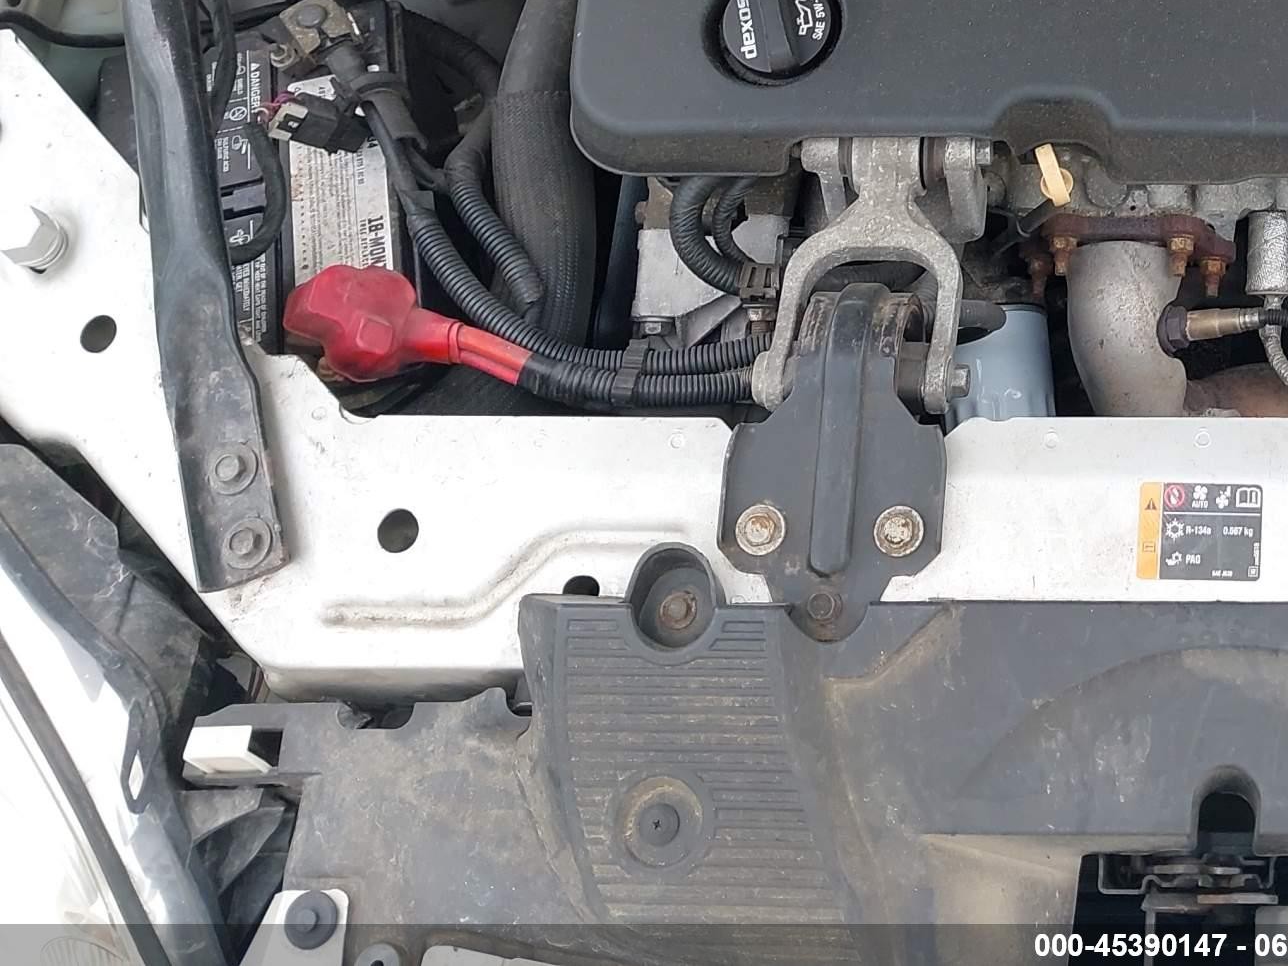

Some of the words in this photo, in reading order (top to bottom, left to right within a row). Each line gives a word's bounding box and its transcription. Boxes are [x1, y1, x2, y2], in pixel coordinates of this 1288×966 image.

[812, 21, 826, 40] SAE
[360, 237, 369, 268] REPLACE
[1192, 500, 1209, 509] AUTO
